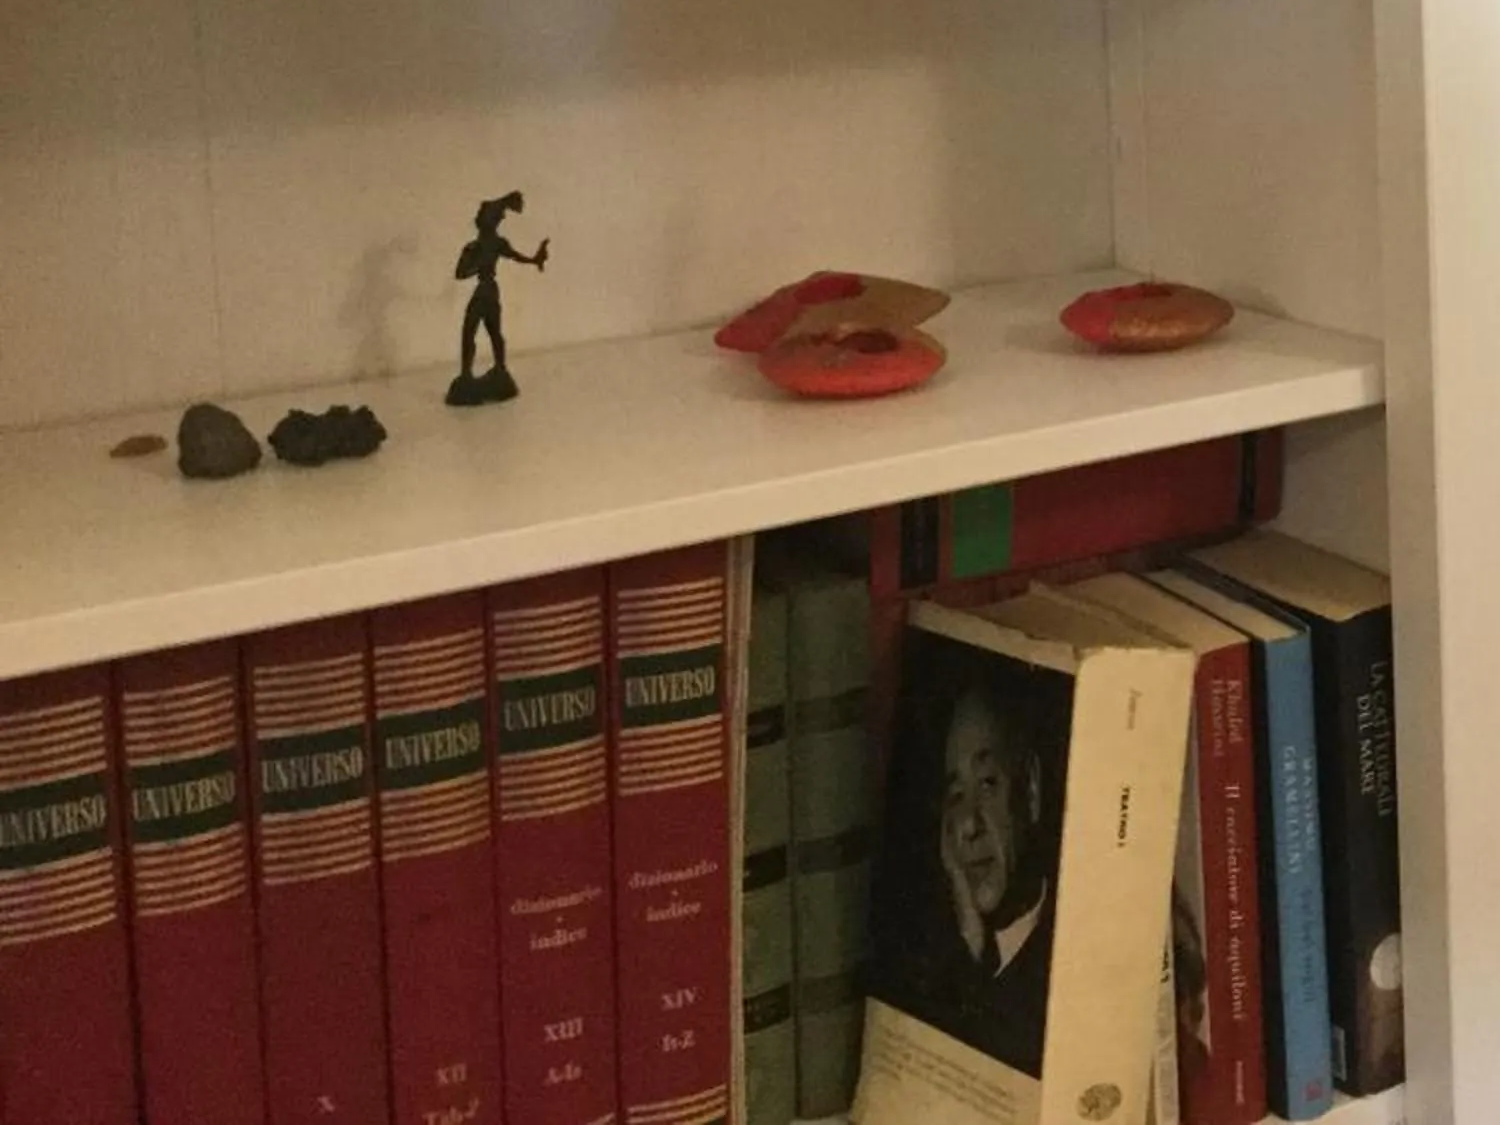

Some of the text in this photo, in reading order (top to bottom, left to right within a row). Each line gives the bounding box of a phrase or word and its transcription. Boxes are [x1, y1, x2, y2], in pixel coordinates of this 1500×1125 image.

[504, 686, 597, 731] UNIVERSO
[625, 665, 716, 708] UNIVERSO
[1226, 679, 1243, 744] Khaled
[385, 720, 480, 769] UNIVERSO
[262, 746, 364, 793] UNIVERSO
[132, 770, 236, 822] UNIVERSO
[0, 794, 107, 846] UNIVERSO
[646, 900, 701, 922] indice
[661, 987, 699, 1011] XIV
[1228, 937, 1246, 1020] aquiloni
[544, 1017, 584, 1043] XIII
